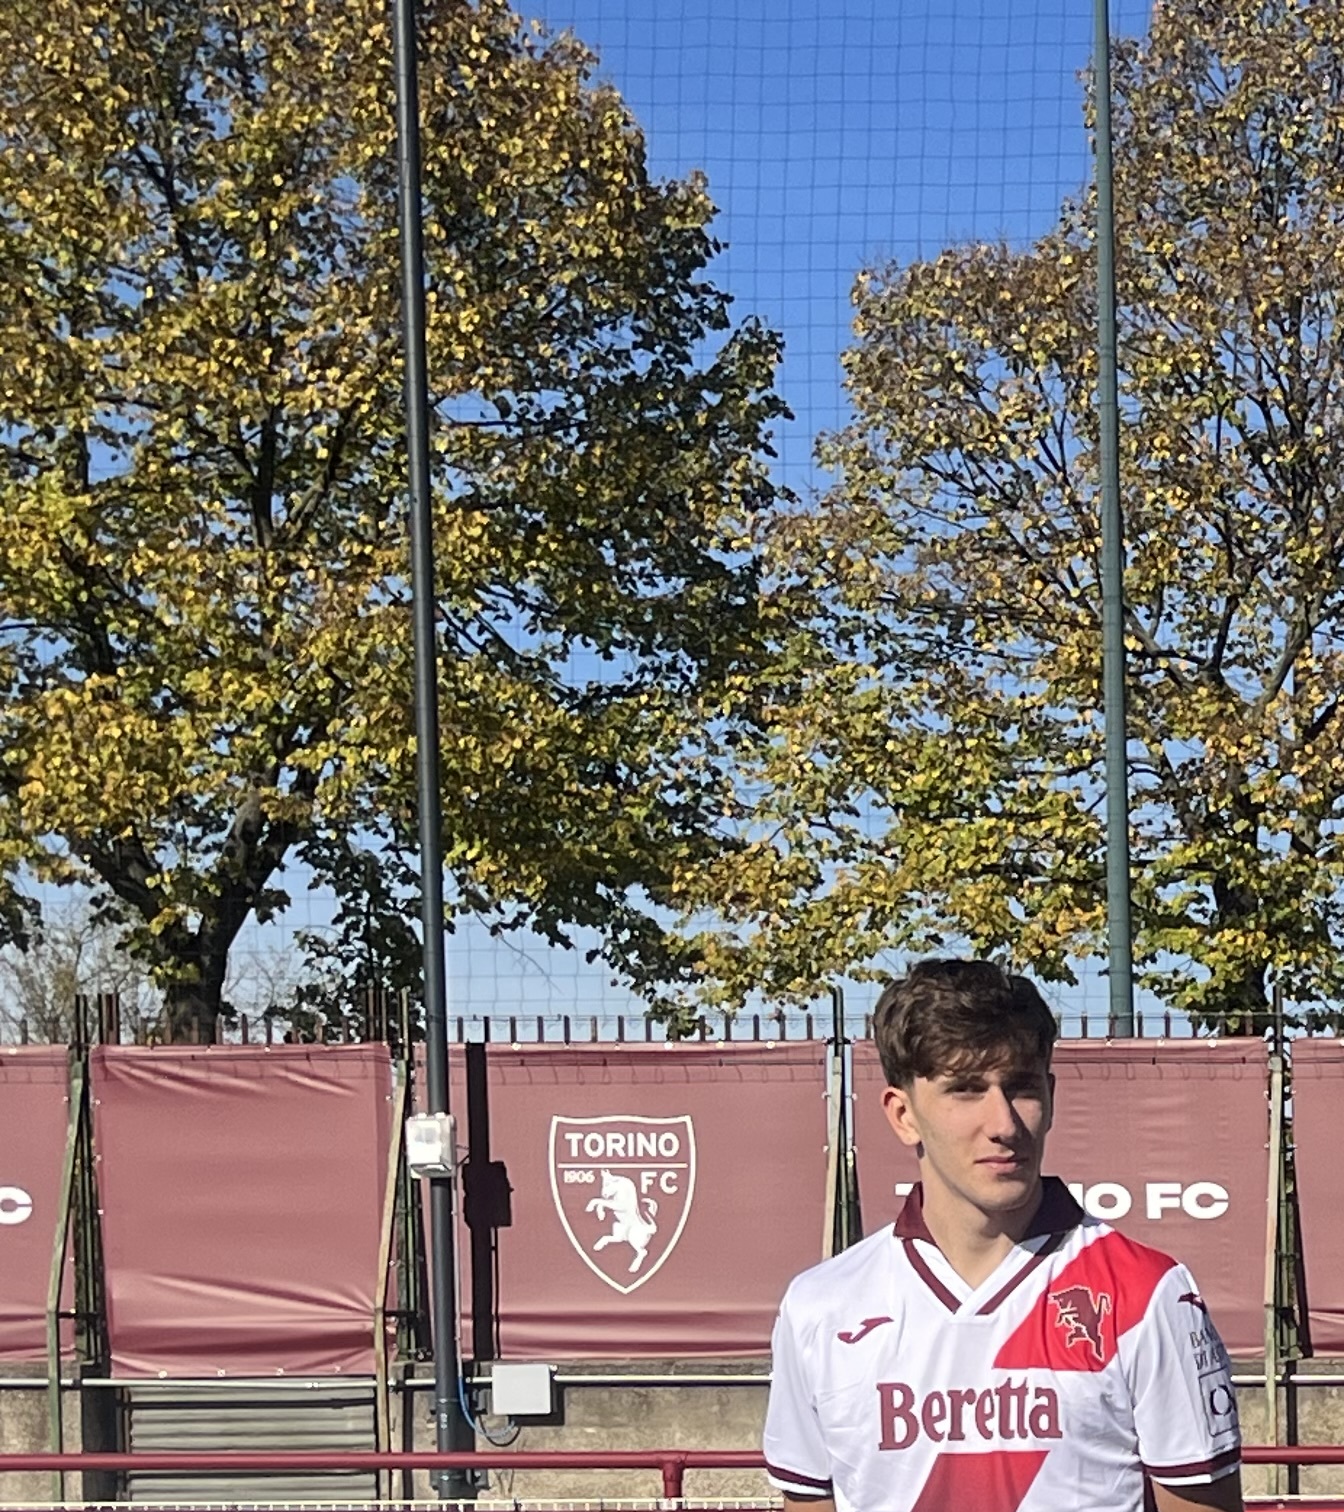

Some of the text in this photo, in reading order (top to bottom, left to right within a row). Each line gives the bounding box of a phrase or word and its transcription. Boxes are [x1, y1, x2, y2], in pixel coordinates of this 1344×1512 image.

[565, 1132, 679, 1157] TORINO
[640, 1171, 678, 1194] FC
[1146, 1182, 1229, 1219] FC
[876, 1377, 1063, 1451] Beretta
